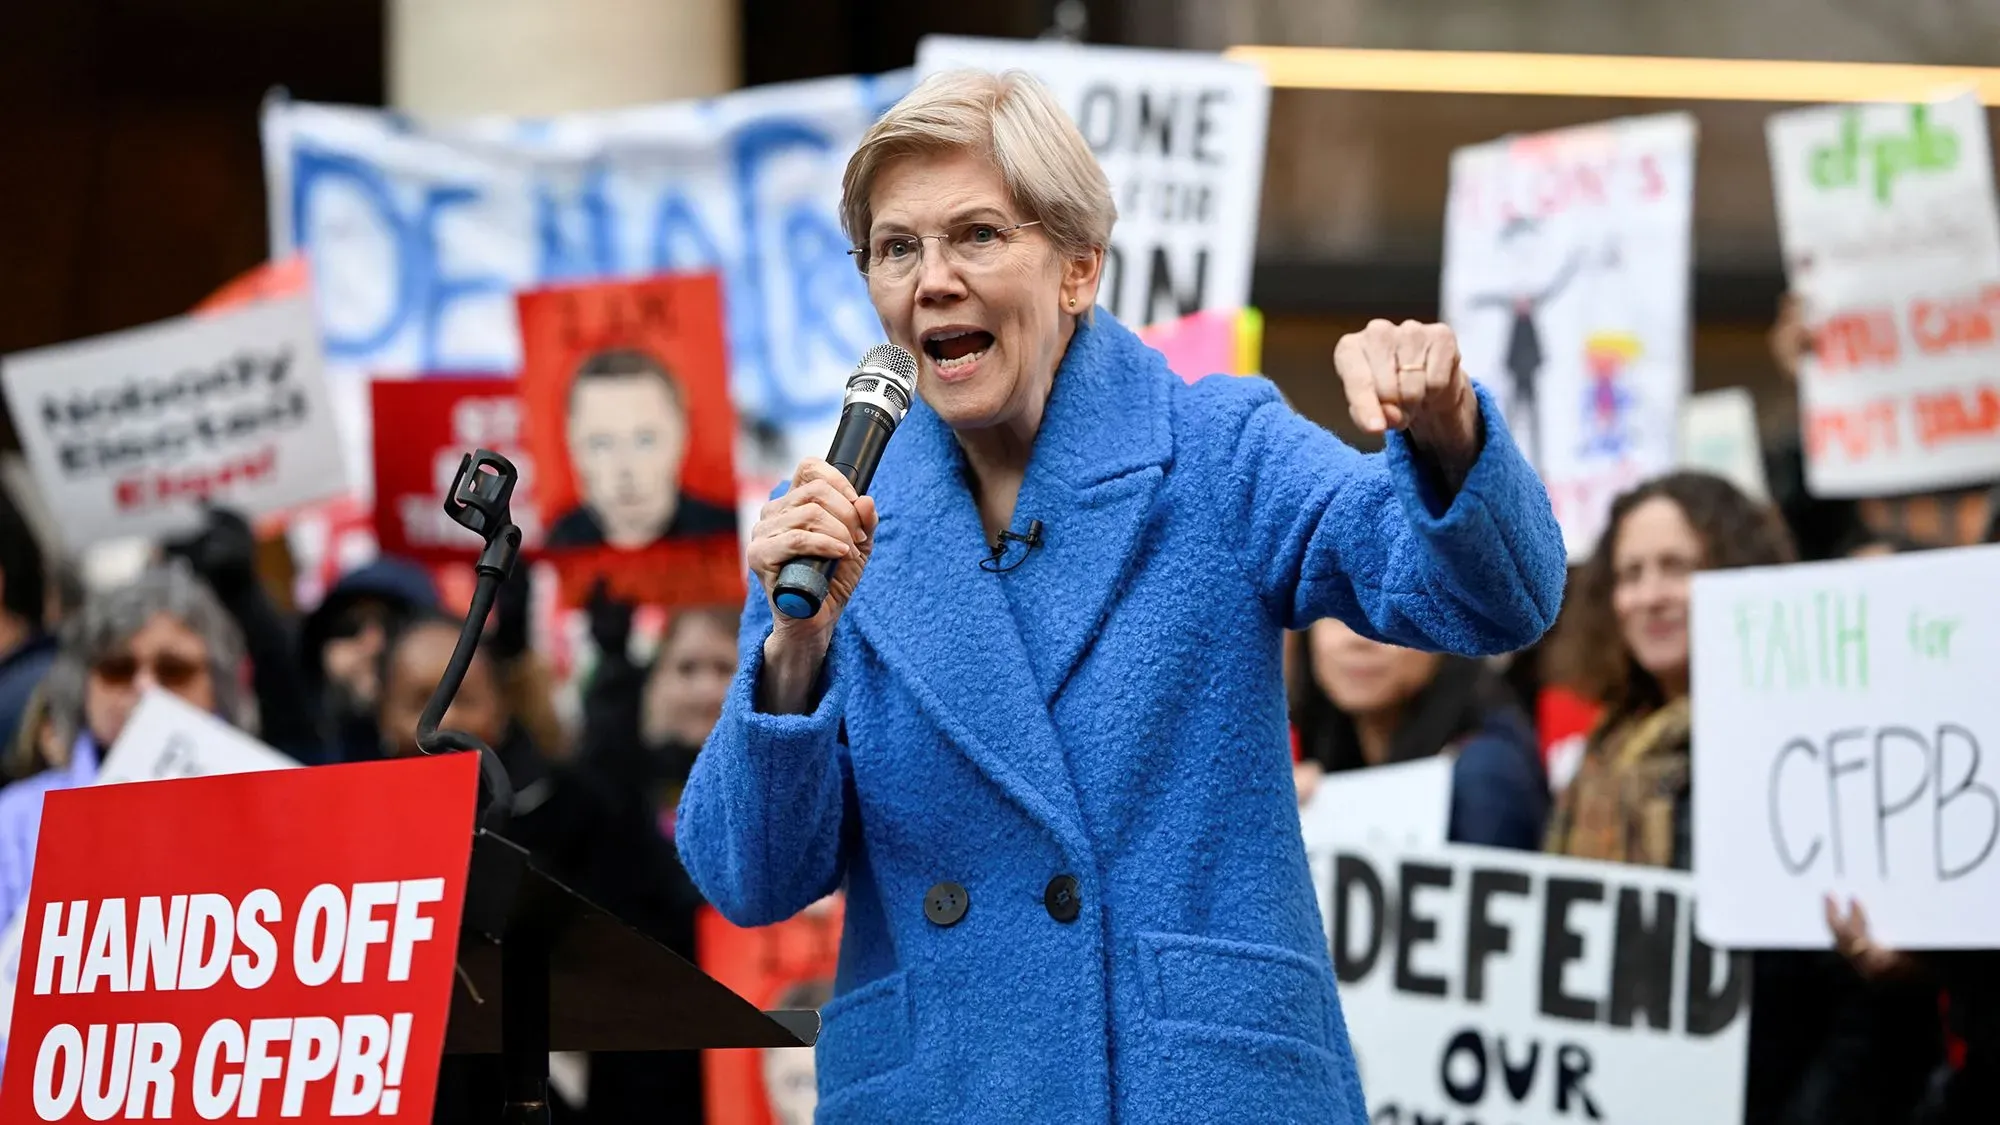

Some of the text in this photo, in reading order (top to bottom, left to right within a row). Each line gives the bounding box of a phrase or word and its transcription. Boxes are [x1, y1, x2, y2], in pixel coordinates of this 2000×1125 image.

[1079, 82, 1230, 165] ONE
[1735, 588, 1869, 689] FAITH
[1767, 722, 2000, 882] CFPB
[33, 877, 445, 995] HANDS OFF
[1332, 850, 1754, 1038] DEFEND
[33, 1013, 413, 1122] OUR CFPB!
[1441, 1026, 1603, 1120] OUR
